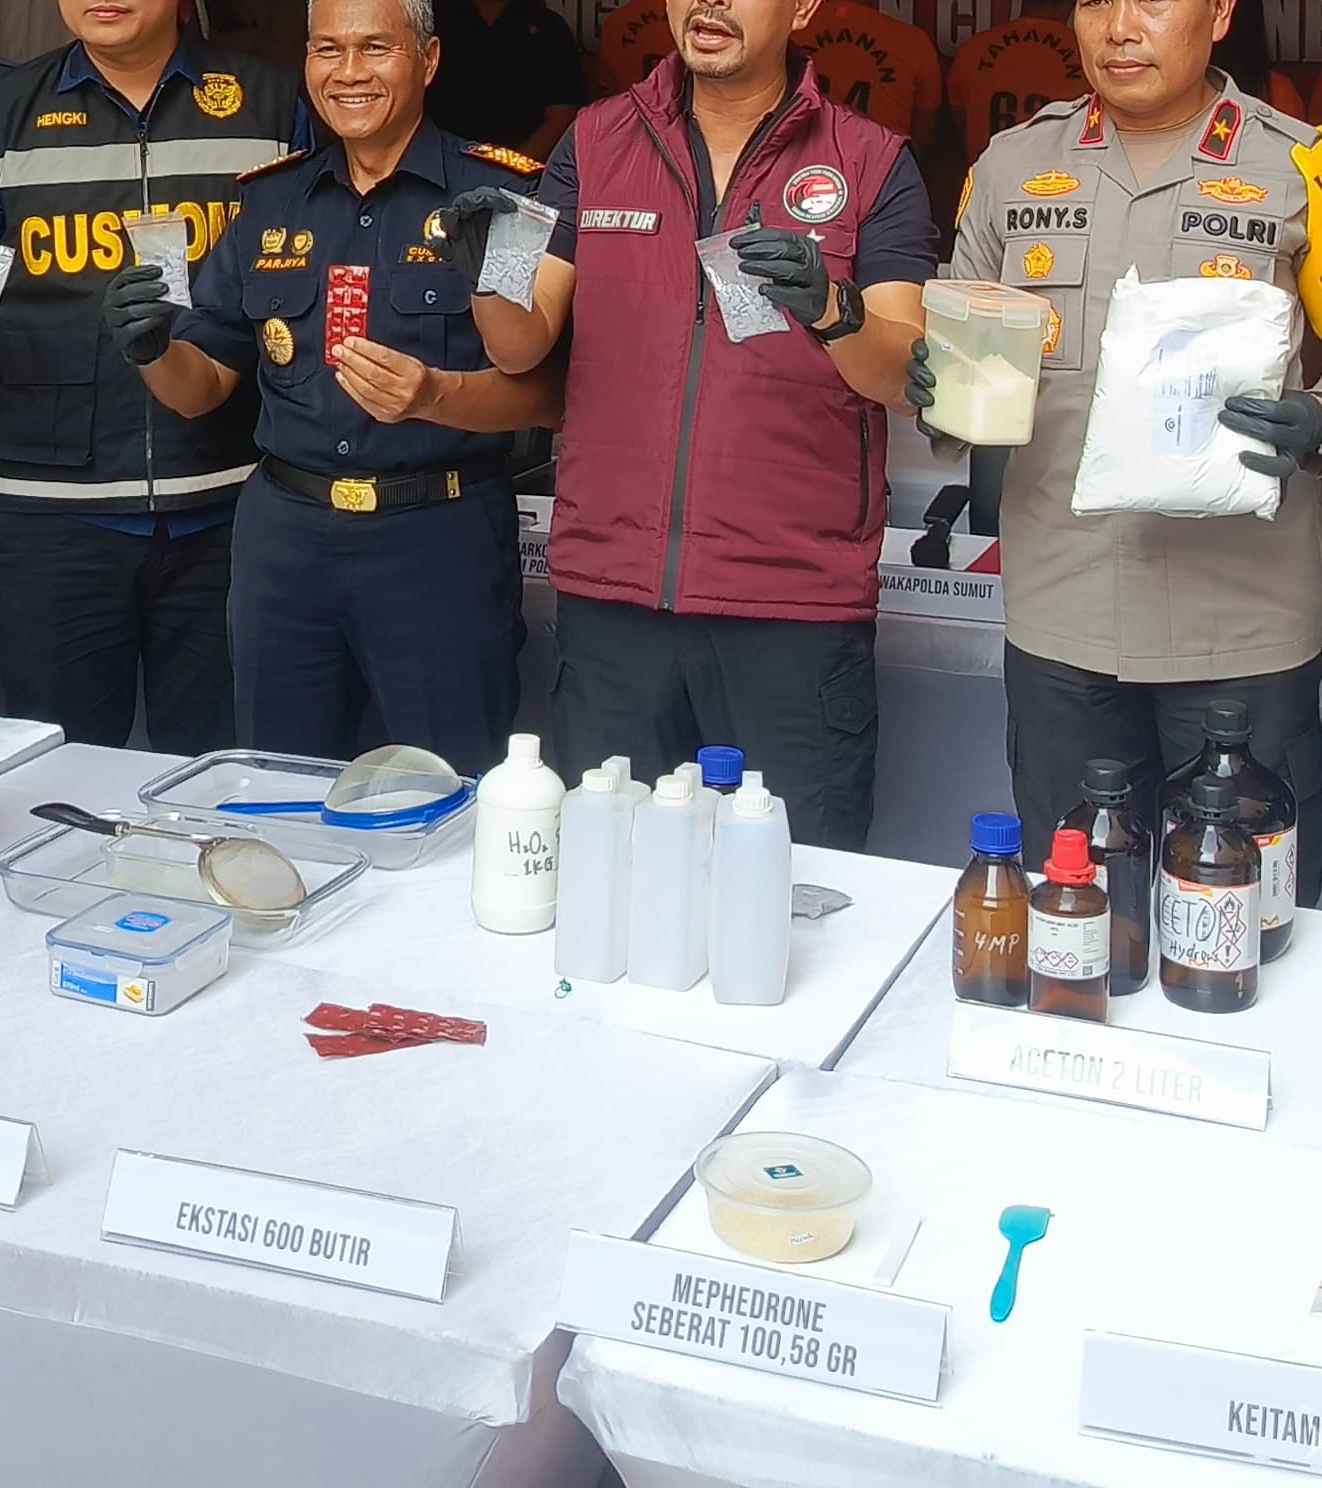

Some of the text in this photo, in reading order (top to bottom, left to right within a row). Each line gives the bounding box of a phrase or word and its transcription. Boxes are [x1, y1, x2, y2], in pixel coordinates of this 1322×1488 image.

[37, 111, 87, 128] HENGKI
[580, 209, 657, 231] DIREKTUR
[1006, 205, 1088, 233] RONY.S
[1181, 212, 1277, 245] POLRI
[878, 573, 994, 600] WAKAPOLDA SUMUT
[1009, 1044, 1203, 1105] ACETON 2 LITER
[176, 1201, 372, 1267] EKSTASI 600 BUTIR
[671, 1272, 827, 1334] MEPHEDRONE
[630, 1300, 858, 1377] SEBERAT 100,58 GR
